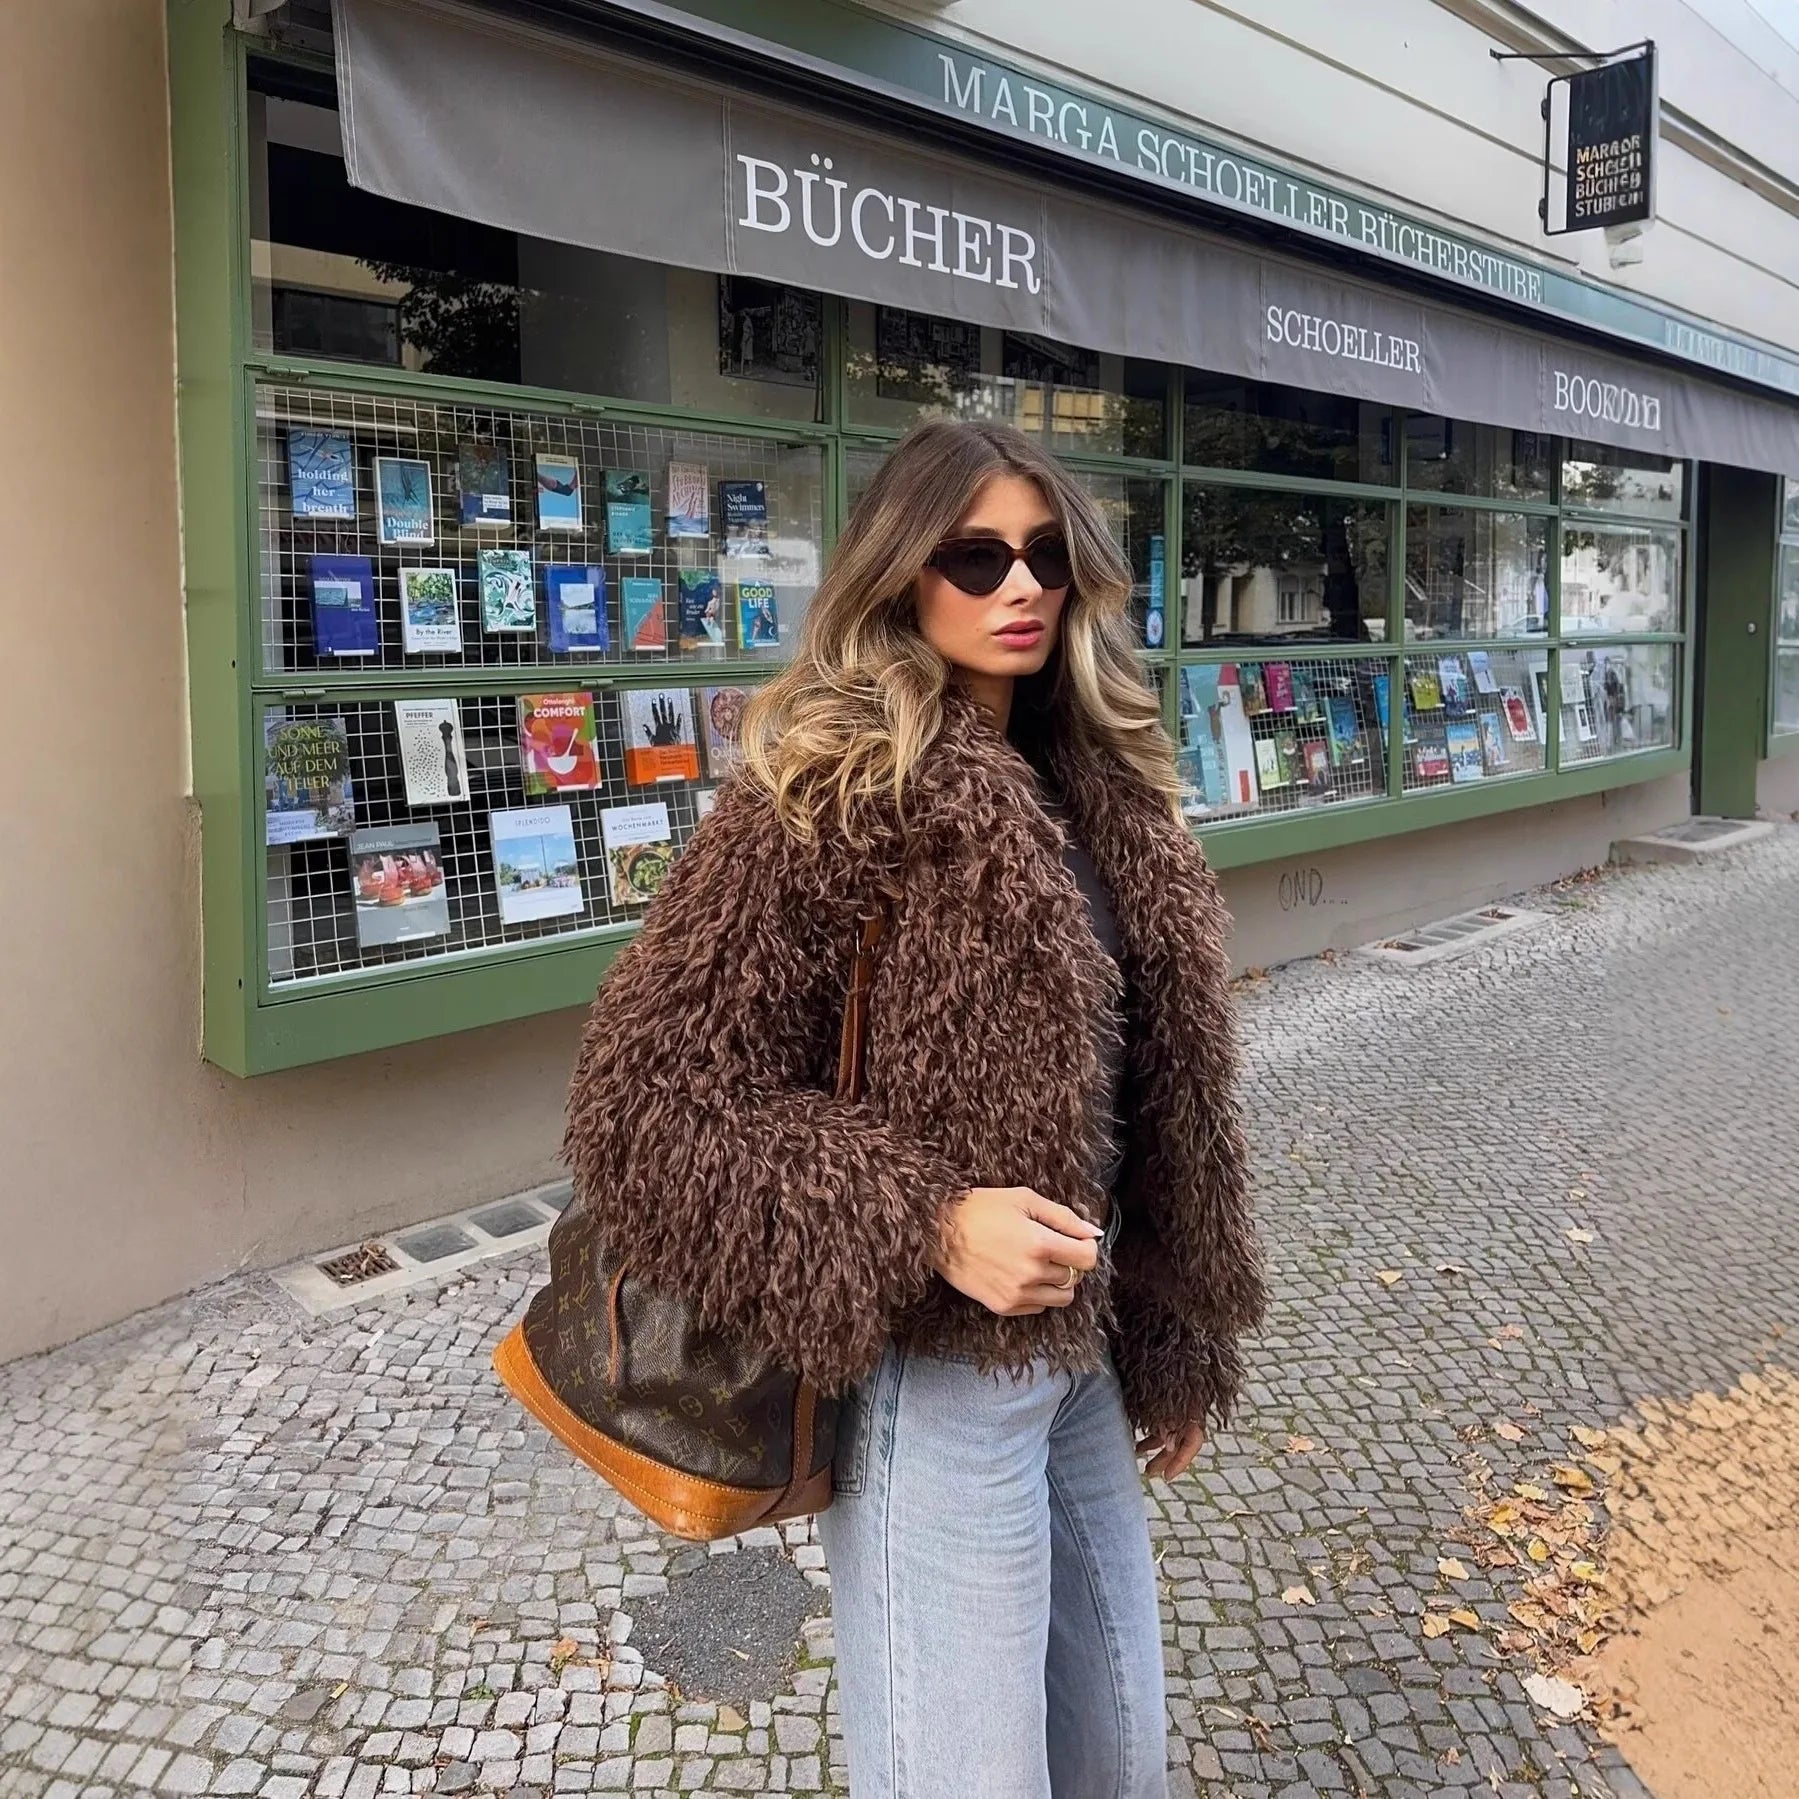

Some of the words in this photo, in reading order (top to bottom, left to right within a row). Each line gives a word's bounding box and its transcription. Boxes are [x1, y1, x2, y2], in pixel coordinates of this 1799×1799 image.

[938, 53, 1121, 161] MARGA
[1137, 129, 1352, 239] SCHOELLER
[1359, 209, 1541, 304] BÜCHERSTUBE
[737, 153, 1041, 294] BÜCHER
[1267, 305, 1422, 374] SCHOELLER
[297, 468, 349, 482] holding
[312, 486, 336, 497] her
[727, 493, 748, 504] Night
[302, 501, 348, 513] breath
[727, 503, 765, 511] Swimmers
[387, 517, 429, 530] Double
[392, 528, 425, 539] Blind
[741, 587, 773, 598] GOOD
[748, 598, 770, 609] LIFE
[533, 706, 586, 718] COMFORT
[281, 726, 326, 741] SONNE
[268, 744, 299, 760] UND
[302, 741, 341, 756] MEER
[276, 761, 301, 776] AUF
[305, 758, 338, 773] DEM
[288, 775, 331, 791] TELLER
[611, 819, 665, 832] WOCHENMARKT
